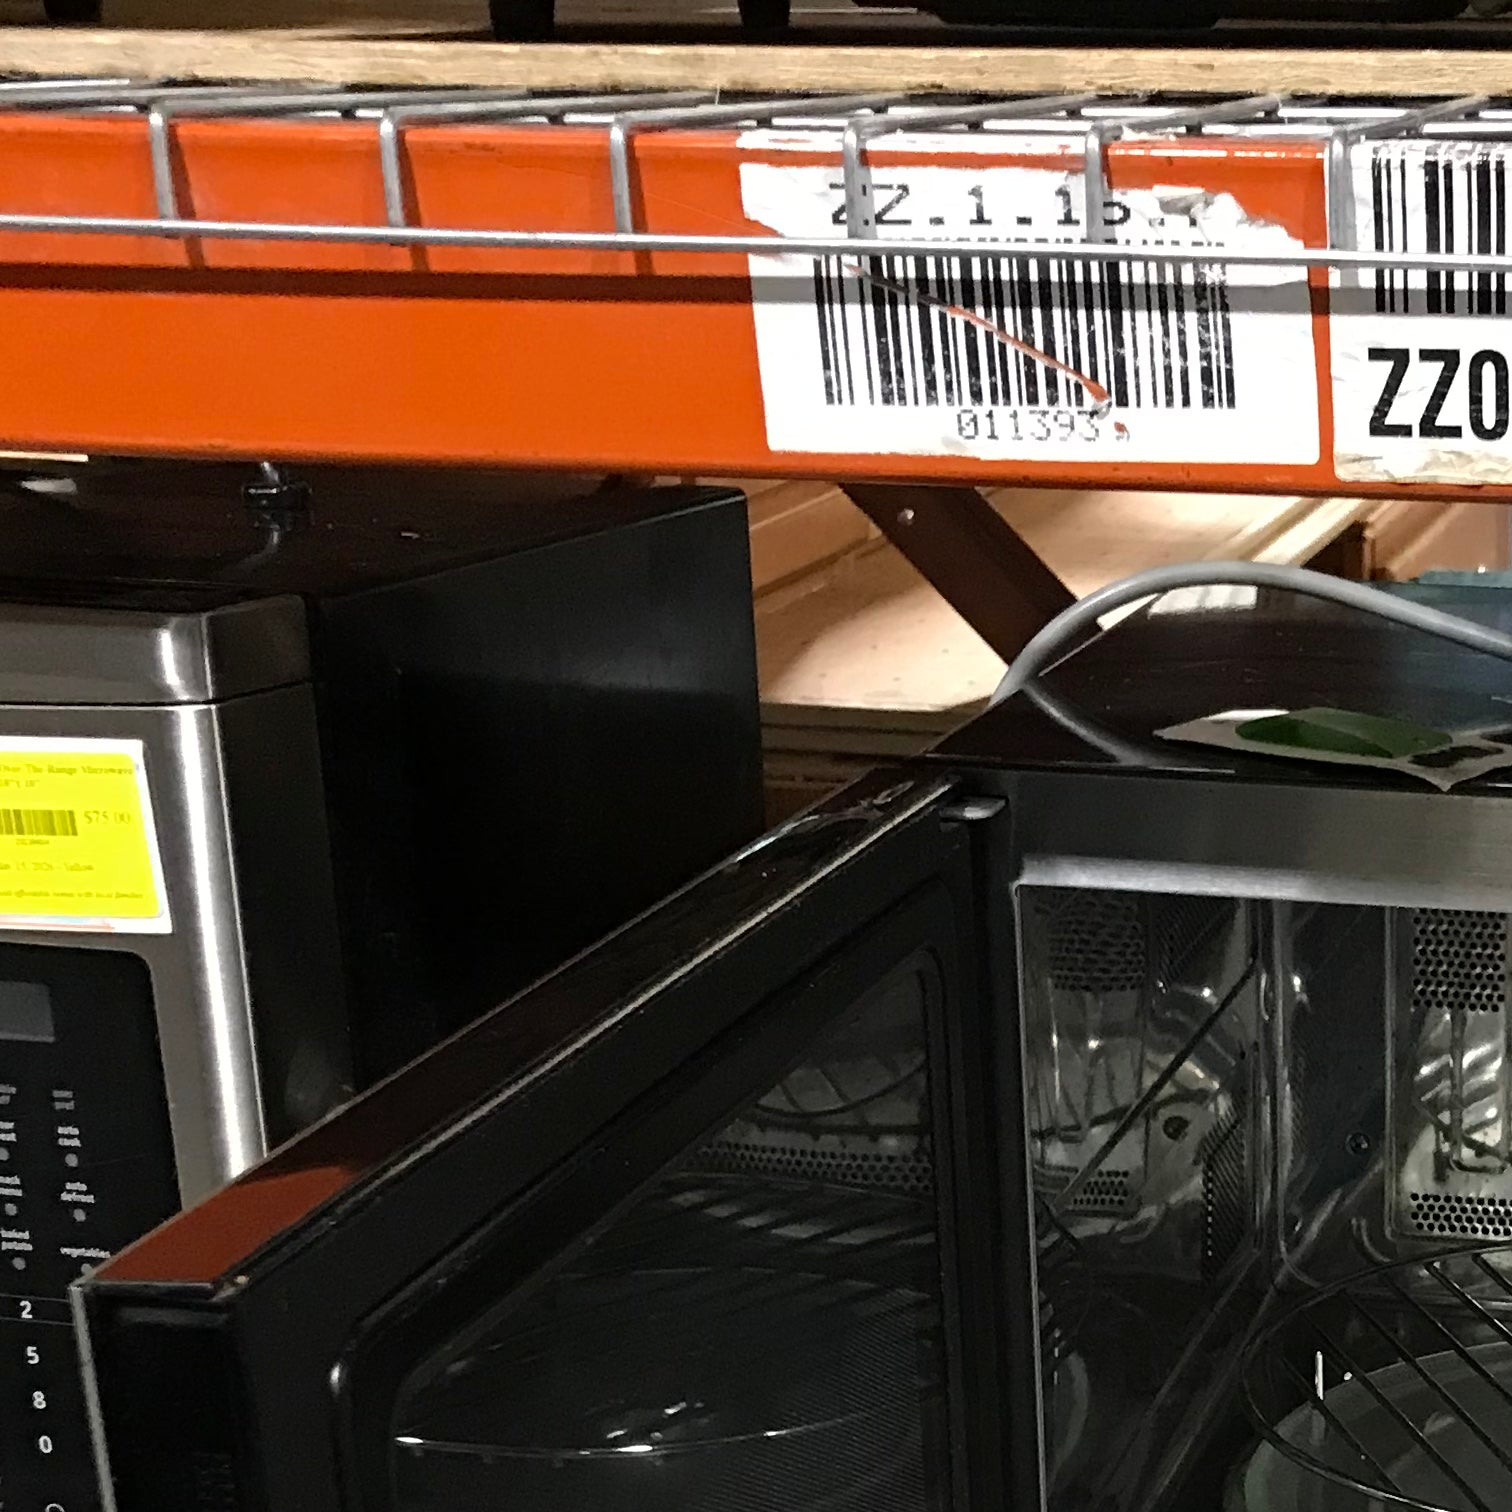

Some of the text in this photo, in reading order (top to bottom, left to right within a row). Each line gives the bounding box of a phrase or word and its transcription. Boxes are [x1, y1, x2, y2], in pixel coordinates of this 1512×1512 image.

[84, 809, 132, 825] $75.00
[19, 1301, 33, 1320] 2
[26, 1346, 40, 1365] 5
[32, 1391, 46, 1409] 8
[38, 1435, 53, 1455] 0
